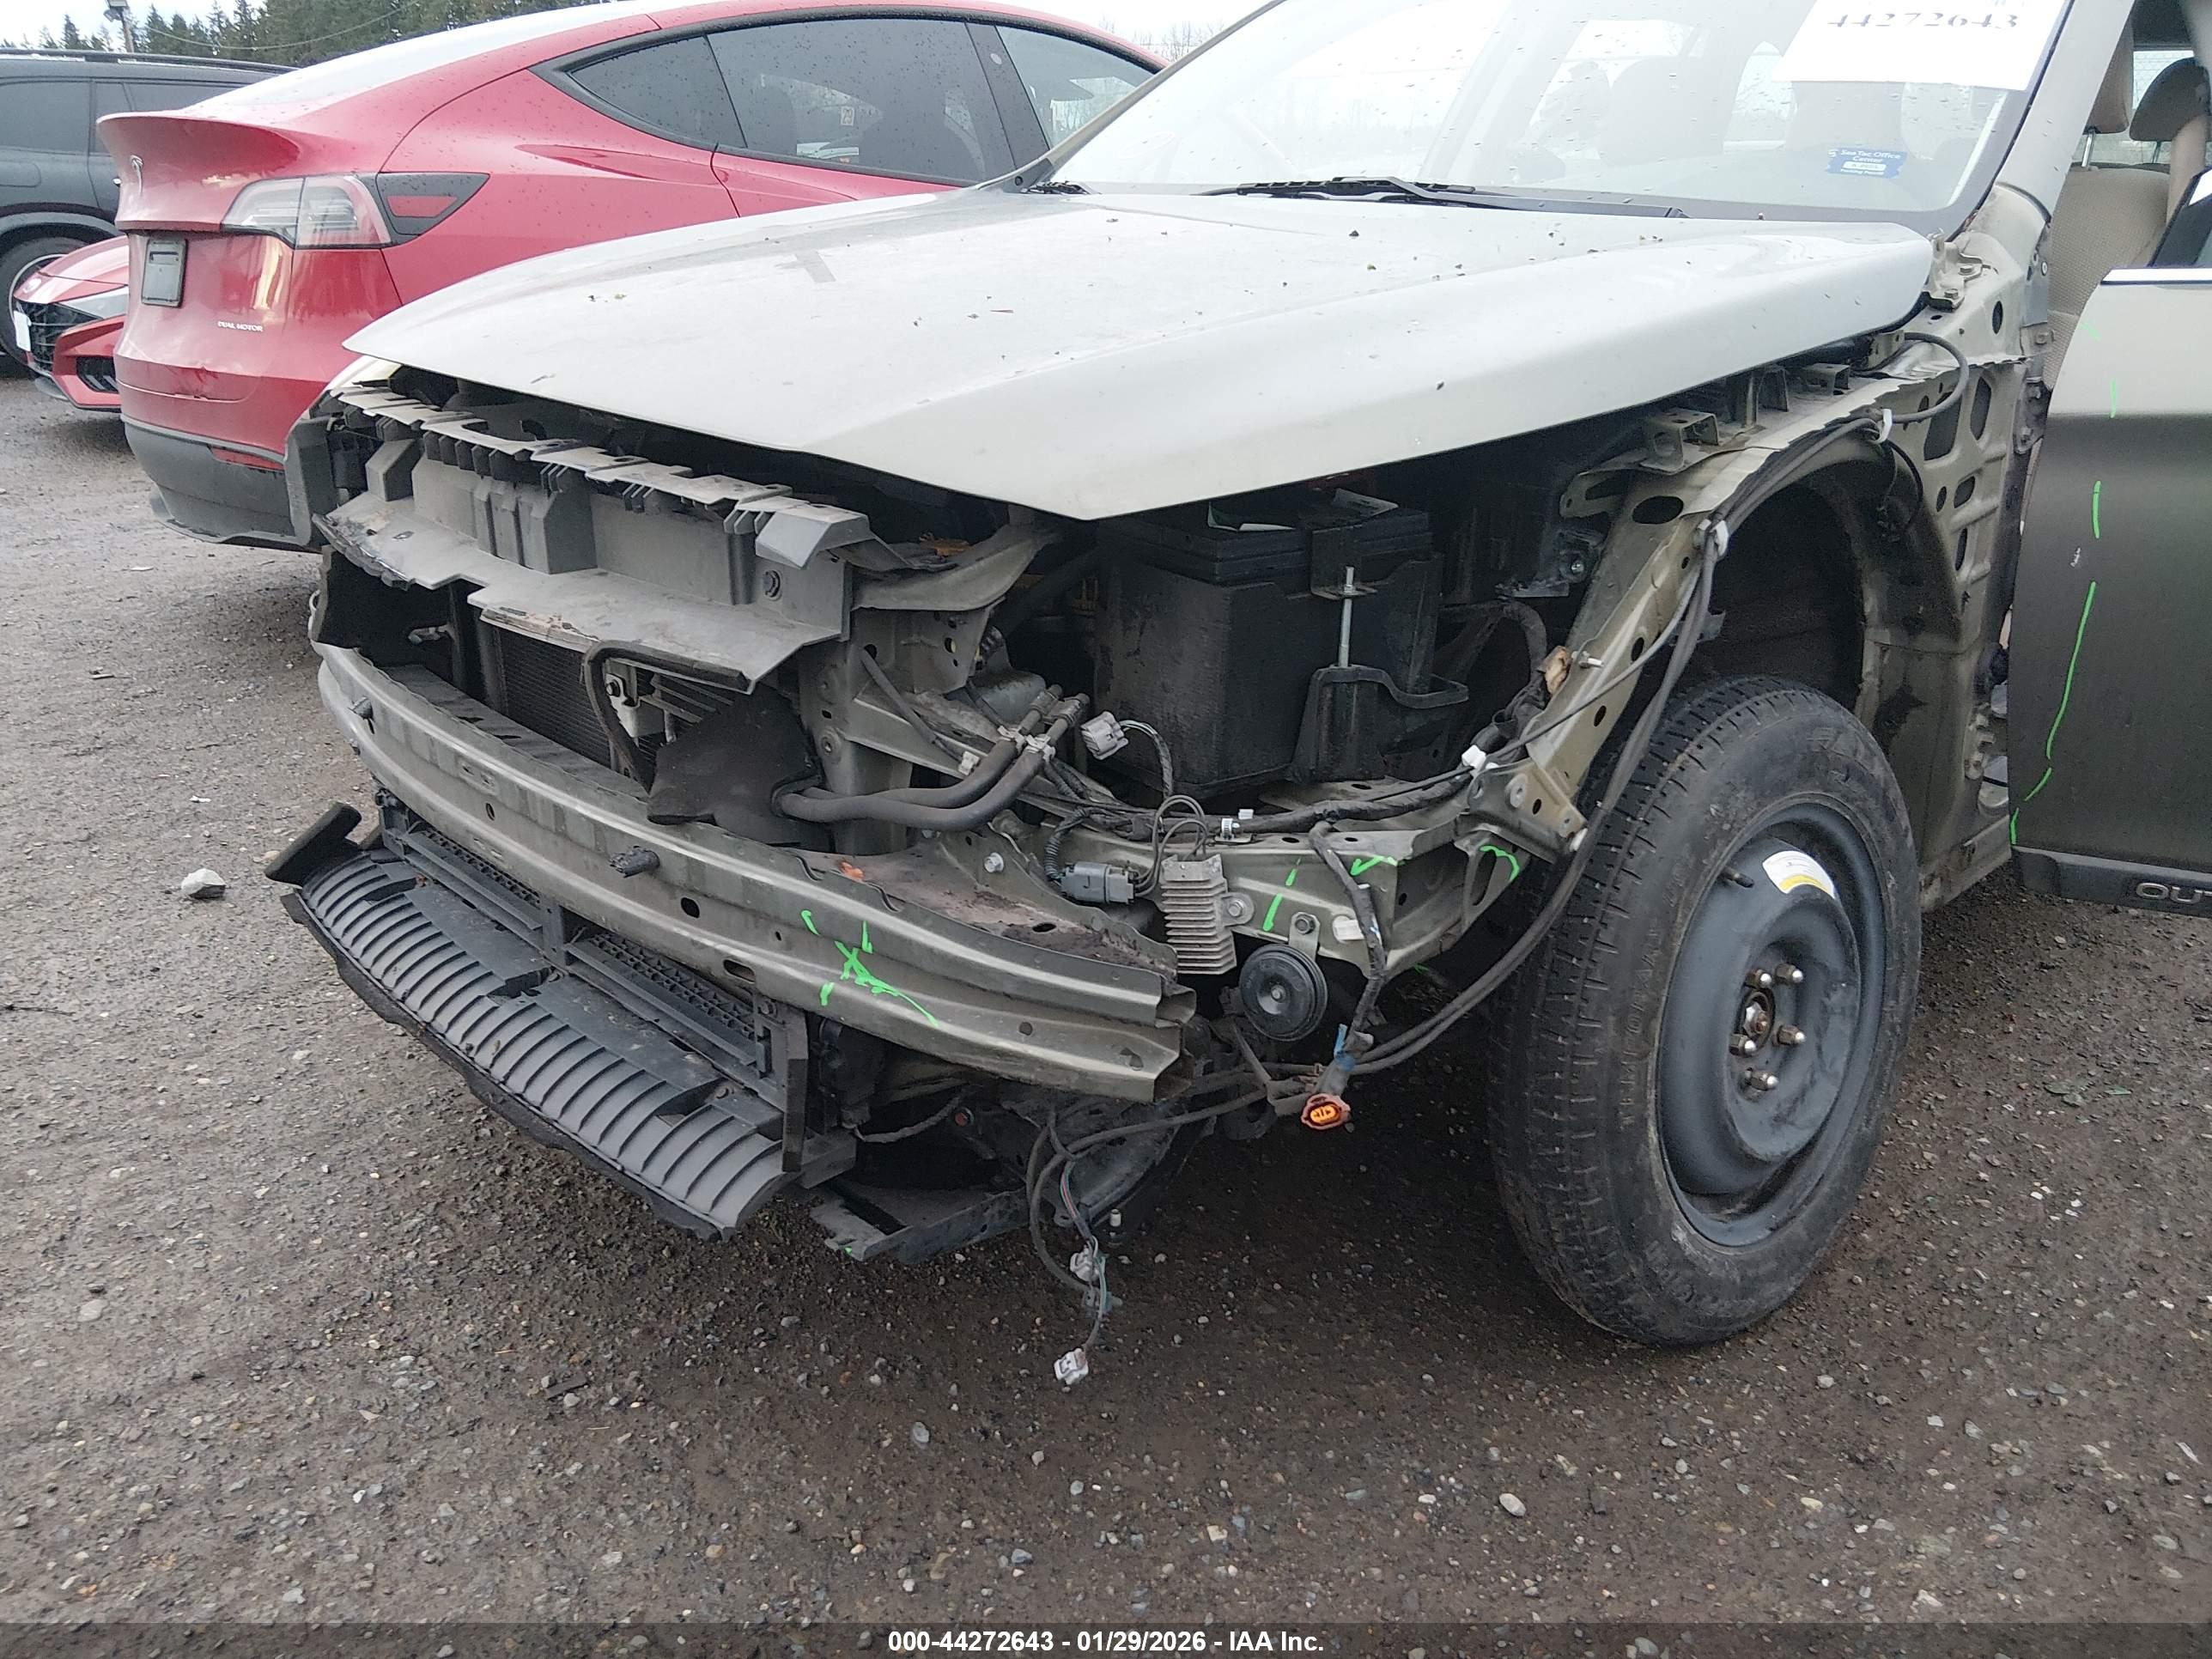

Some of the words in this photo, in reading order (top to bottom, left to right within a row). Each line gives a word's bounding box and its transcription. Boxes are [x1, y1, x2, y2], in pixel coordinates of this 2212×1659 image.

[1827, 12, 2018, 29] 44272643
[218, 321, 236, 330] DUAL
[236, 324, 263, 332] MOTOR
